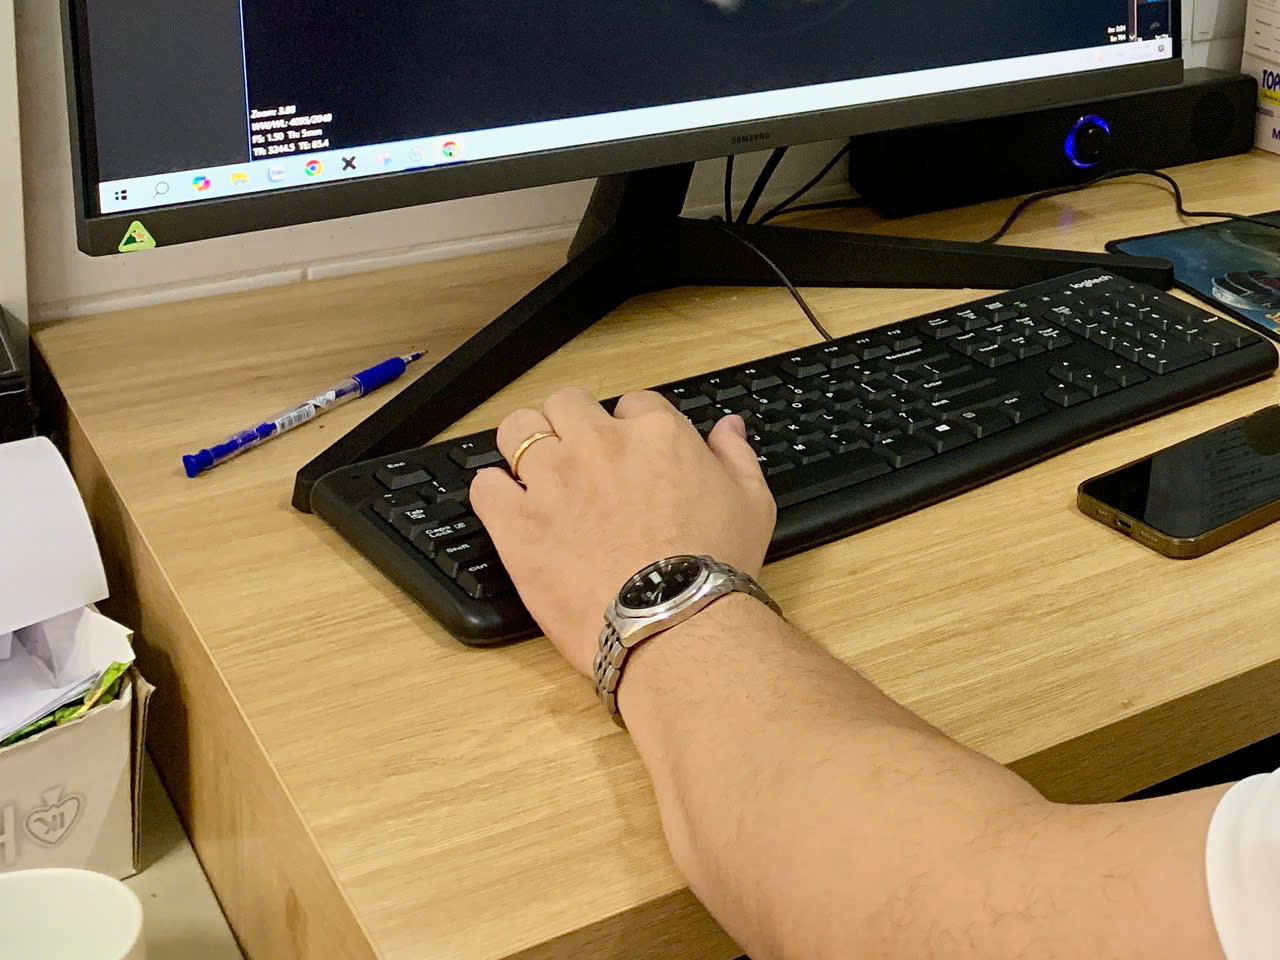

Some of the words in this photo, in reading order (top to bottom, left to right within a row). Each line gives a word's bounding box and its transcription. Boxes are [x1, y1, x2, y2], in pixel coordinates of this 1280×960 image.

[1069, 274, 1114, 289] logitech
[425, 525, 451, 535] Caps
[446, 543, 470, 553] Shift
[468, 563, 488, 572] Ctrl
